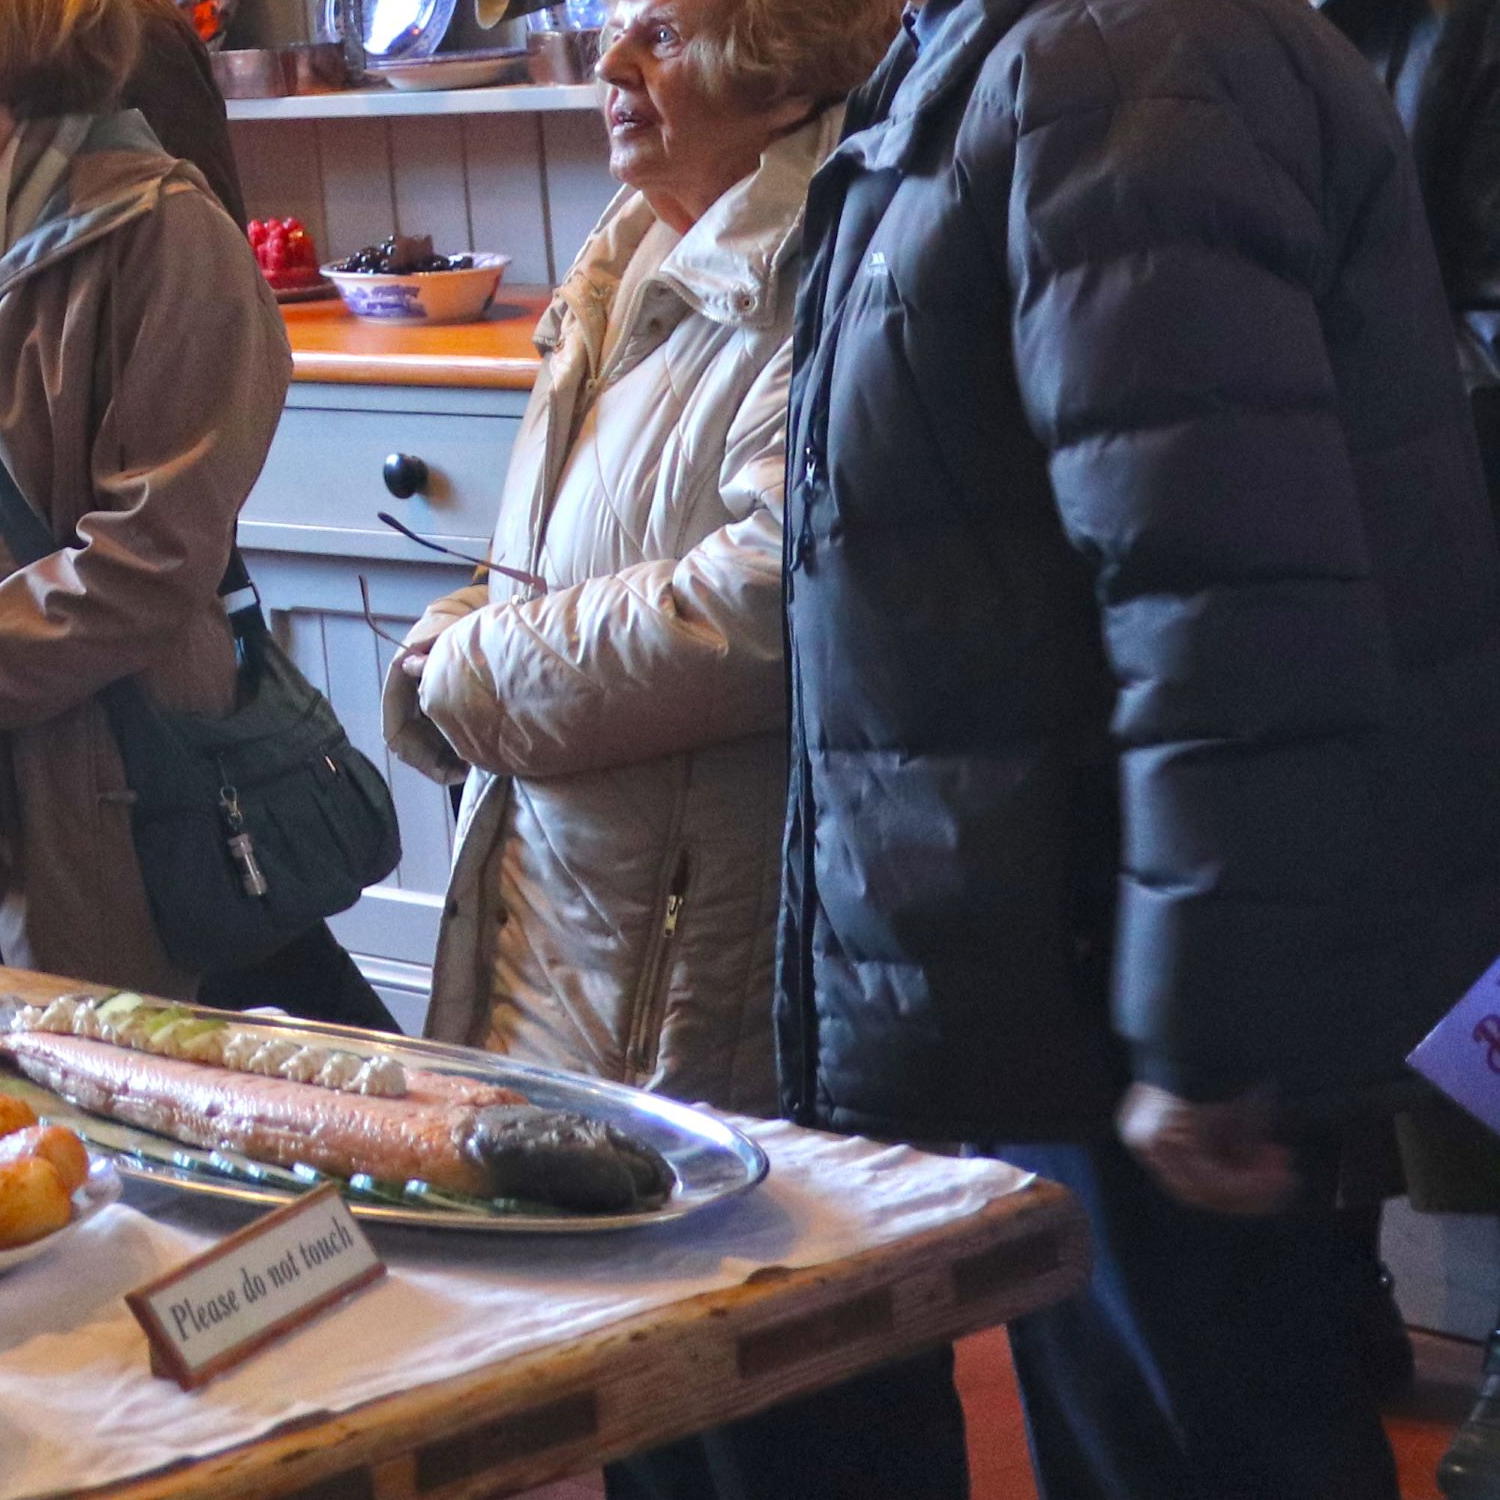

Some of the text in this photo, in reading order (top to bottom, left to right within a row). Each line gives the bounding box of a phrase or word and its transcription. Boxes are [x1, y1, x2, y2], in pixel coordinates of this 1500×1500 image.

[169, 1216, 355, 1341] Please do not touch
